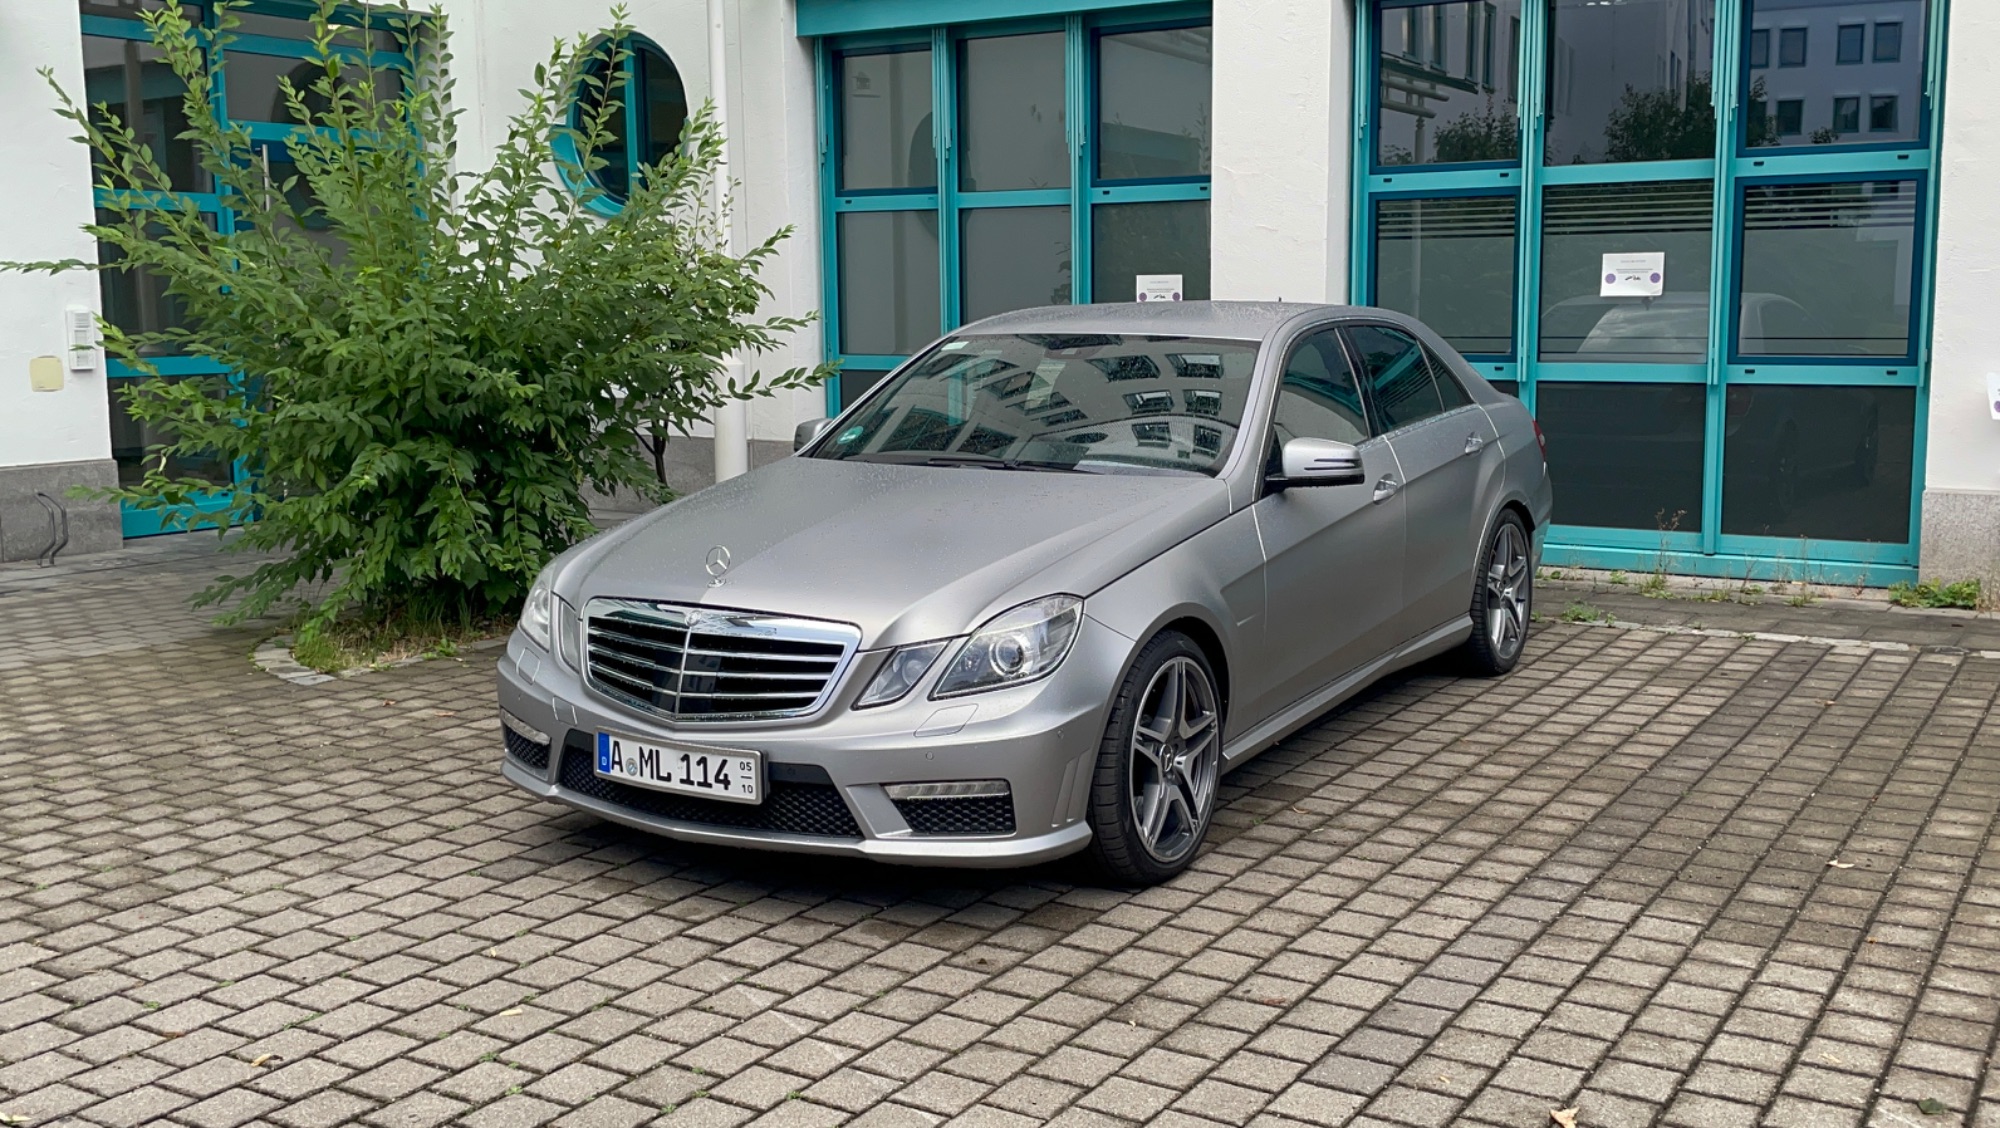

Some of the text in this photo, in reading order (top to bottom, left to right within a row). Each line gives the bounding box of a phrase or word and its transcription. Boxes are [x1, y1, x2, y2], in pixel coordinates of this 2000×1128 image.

[611, 740, 731, 790] A ML 114
[740, 761, 752, 771] 05
[742, 784, 753, 794] 10
